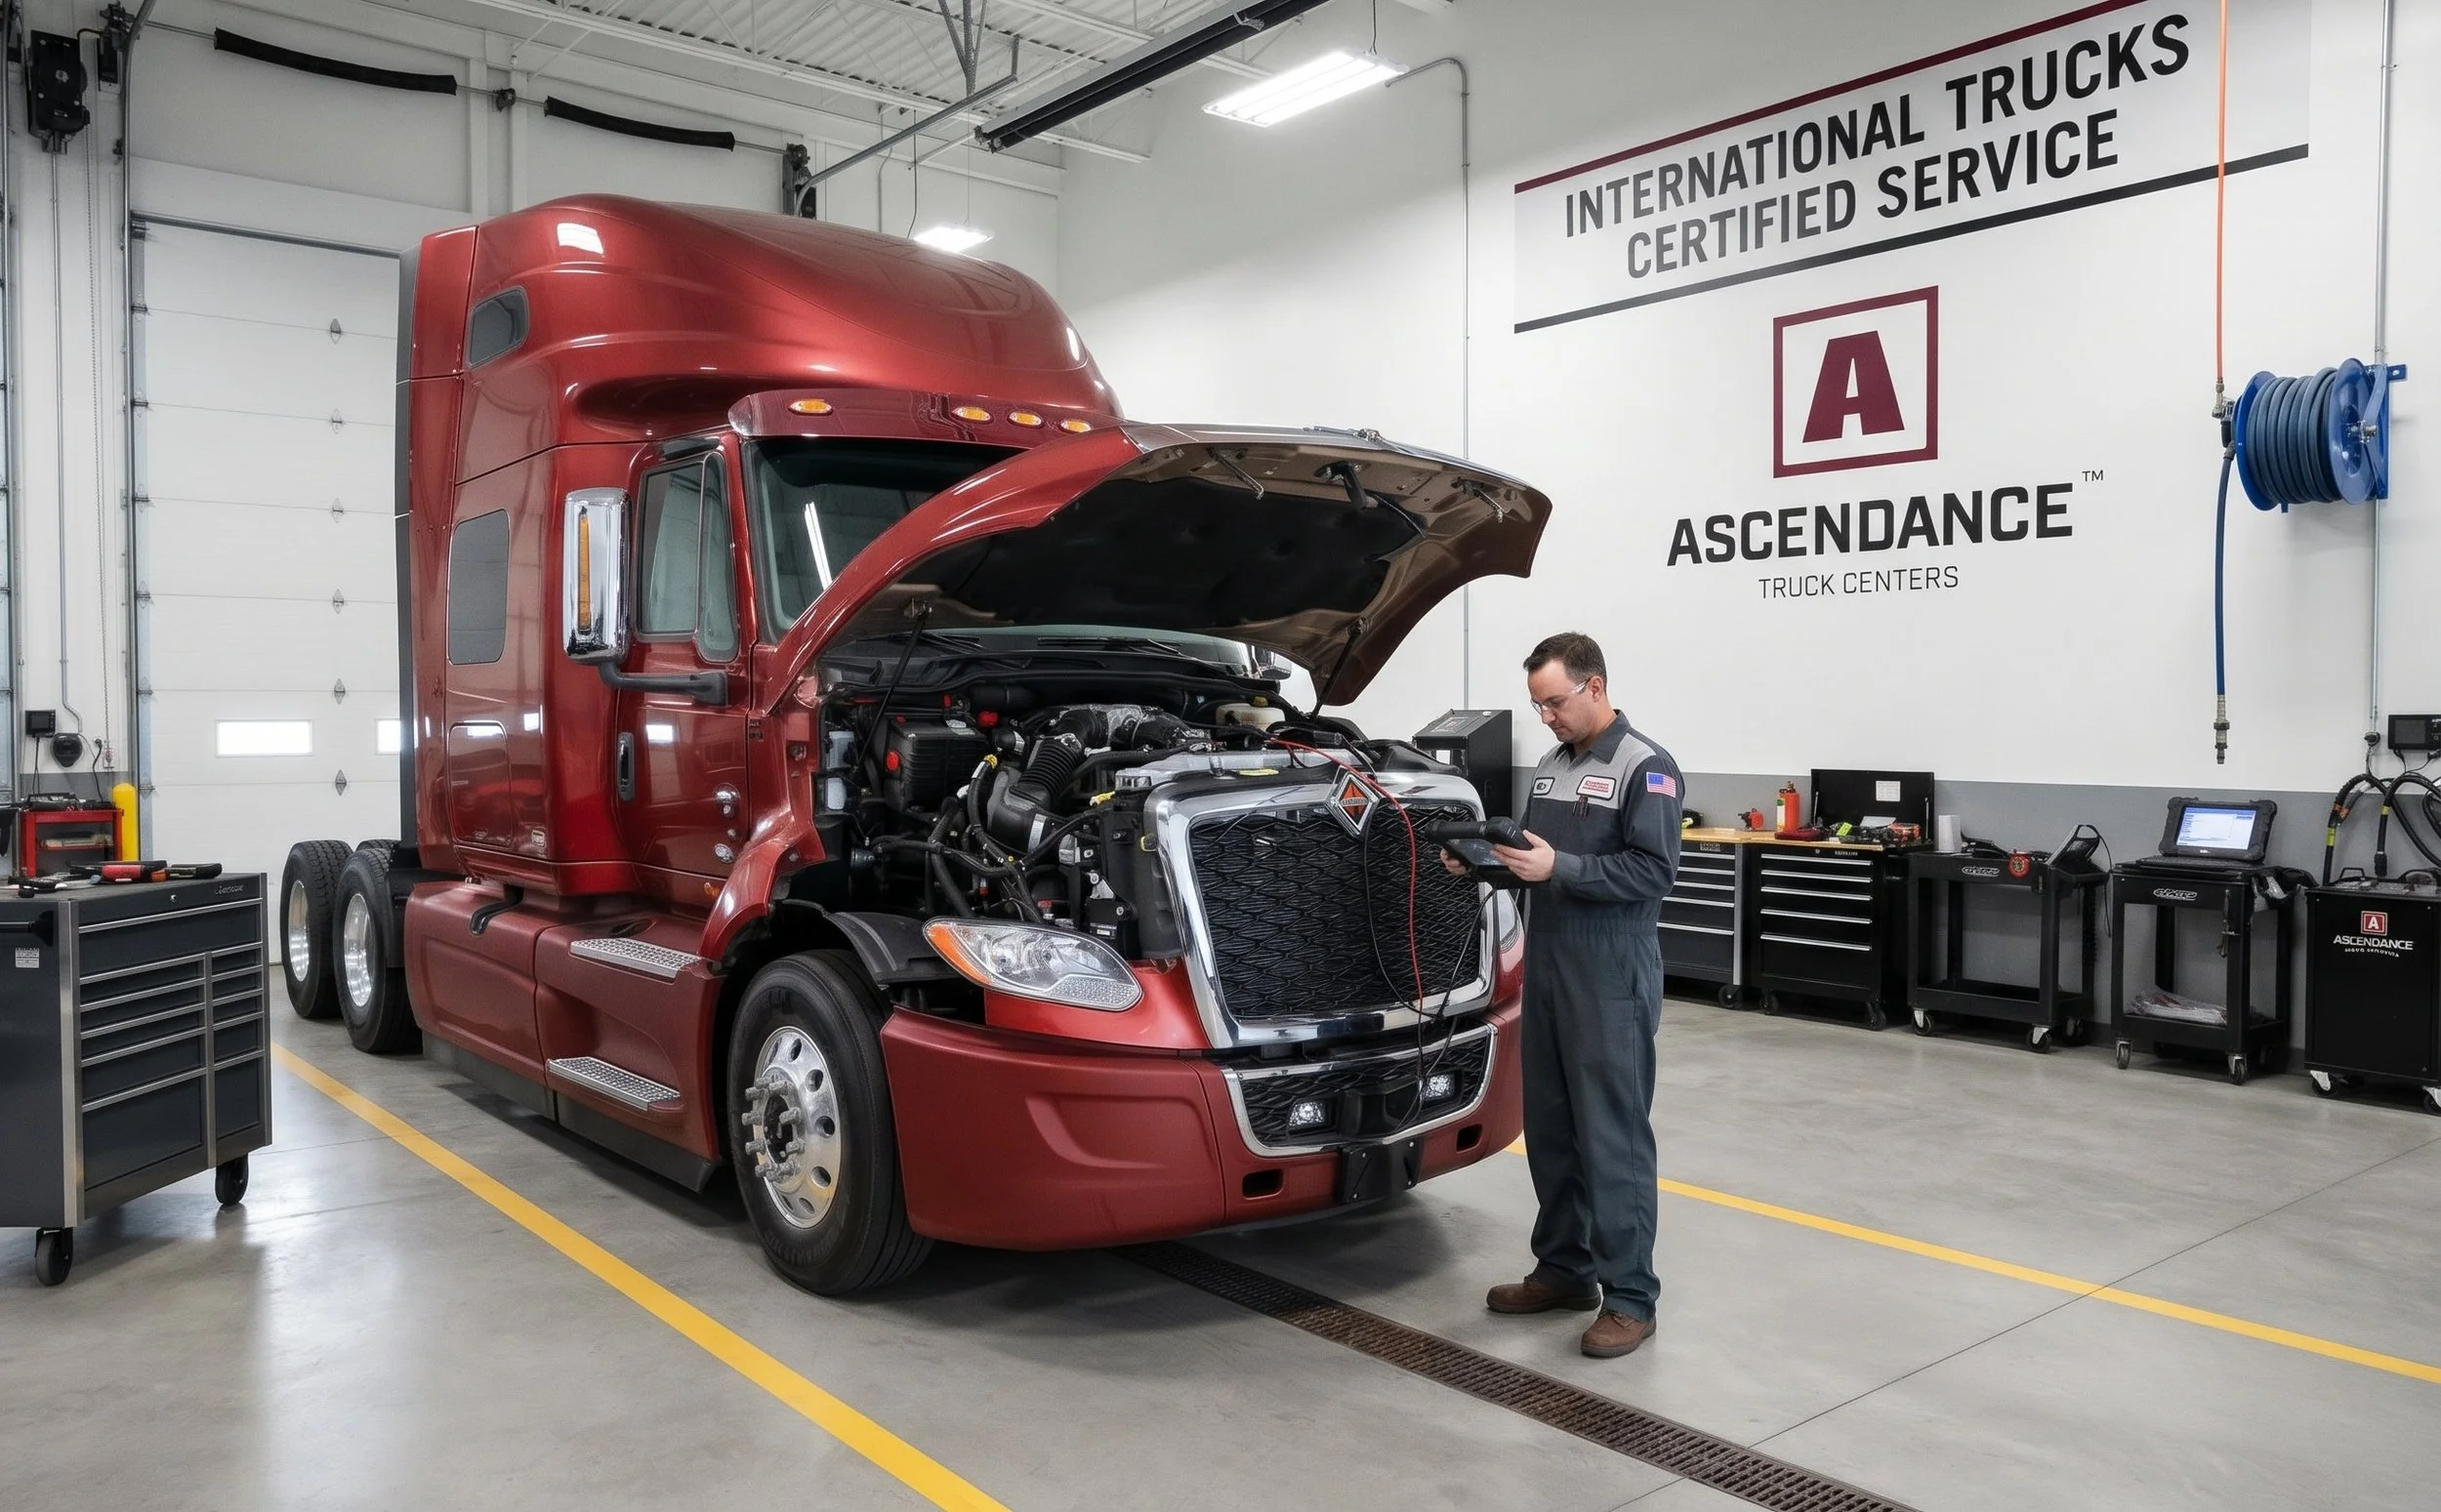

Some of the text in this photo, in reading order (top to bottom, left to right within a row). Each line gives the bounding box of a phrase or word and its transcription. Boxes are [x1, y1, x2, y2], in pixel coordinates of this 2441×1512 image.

[1565, 14, 2190, 239] INTERNATIONAL TRUCKS
[1627, 108, 2119, 279] CERTIFIED SERVICE
[1667, 481, 2074, 567] ASCENDANCE
[1758, 565, 1960, 599] TRUCK CENTERS
[2333, 935, 2414, 951] ASCENDANCE
